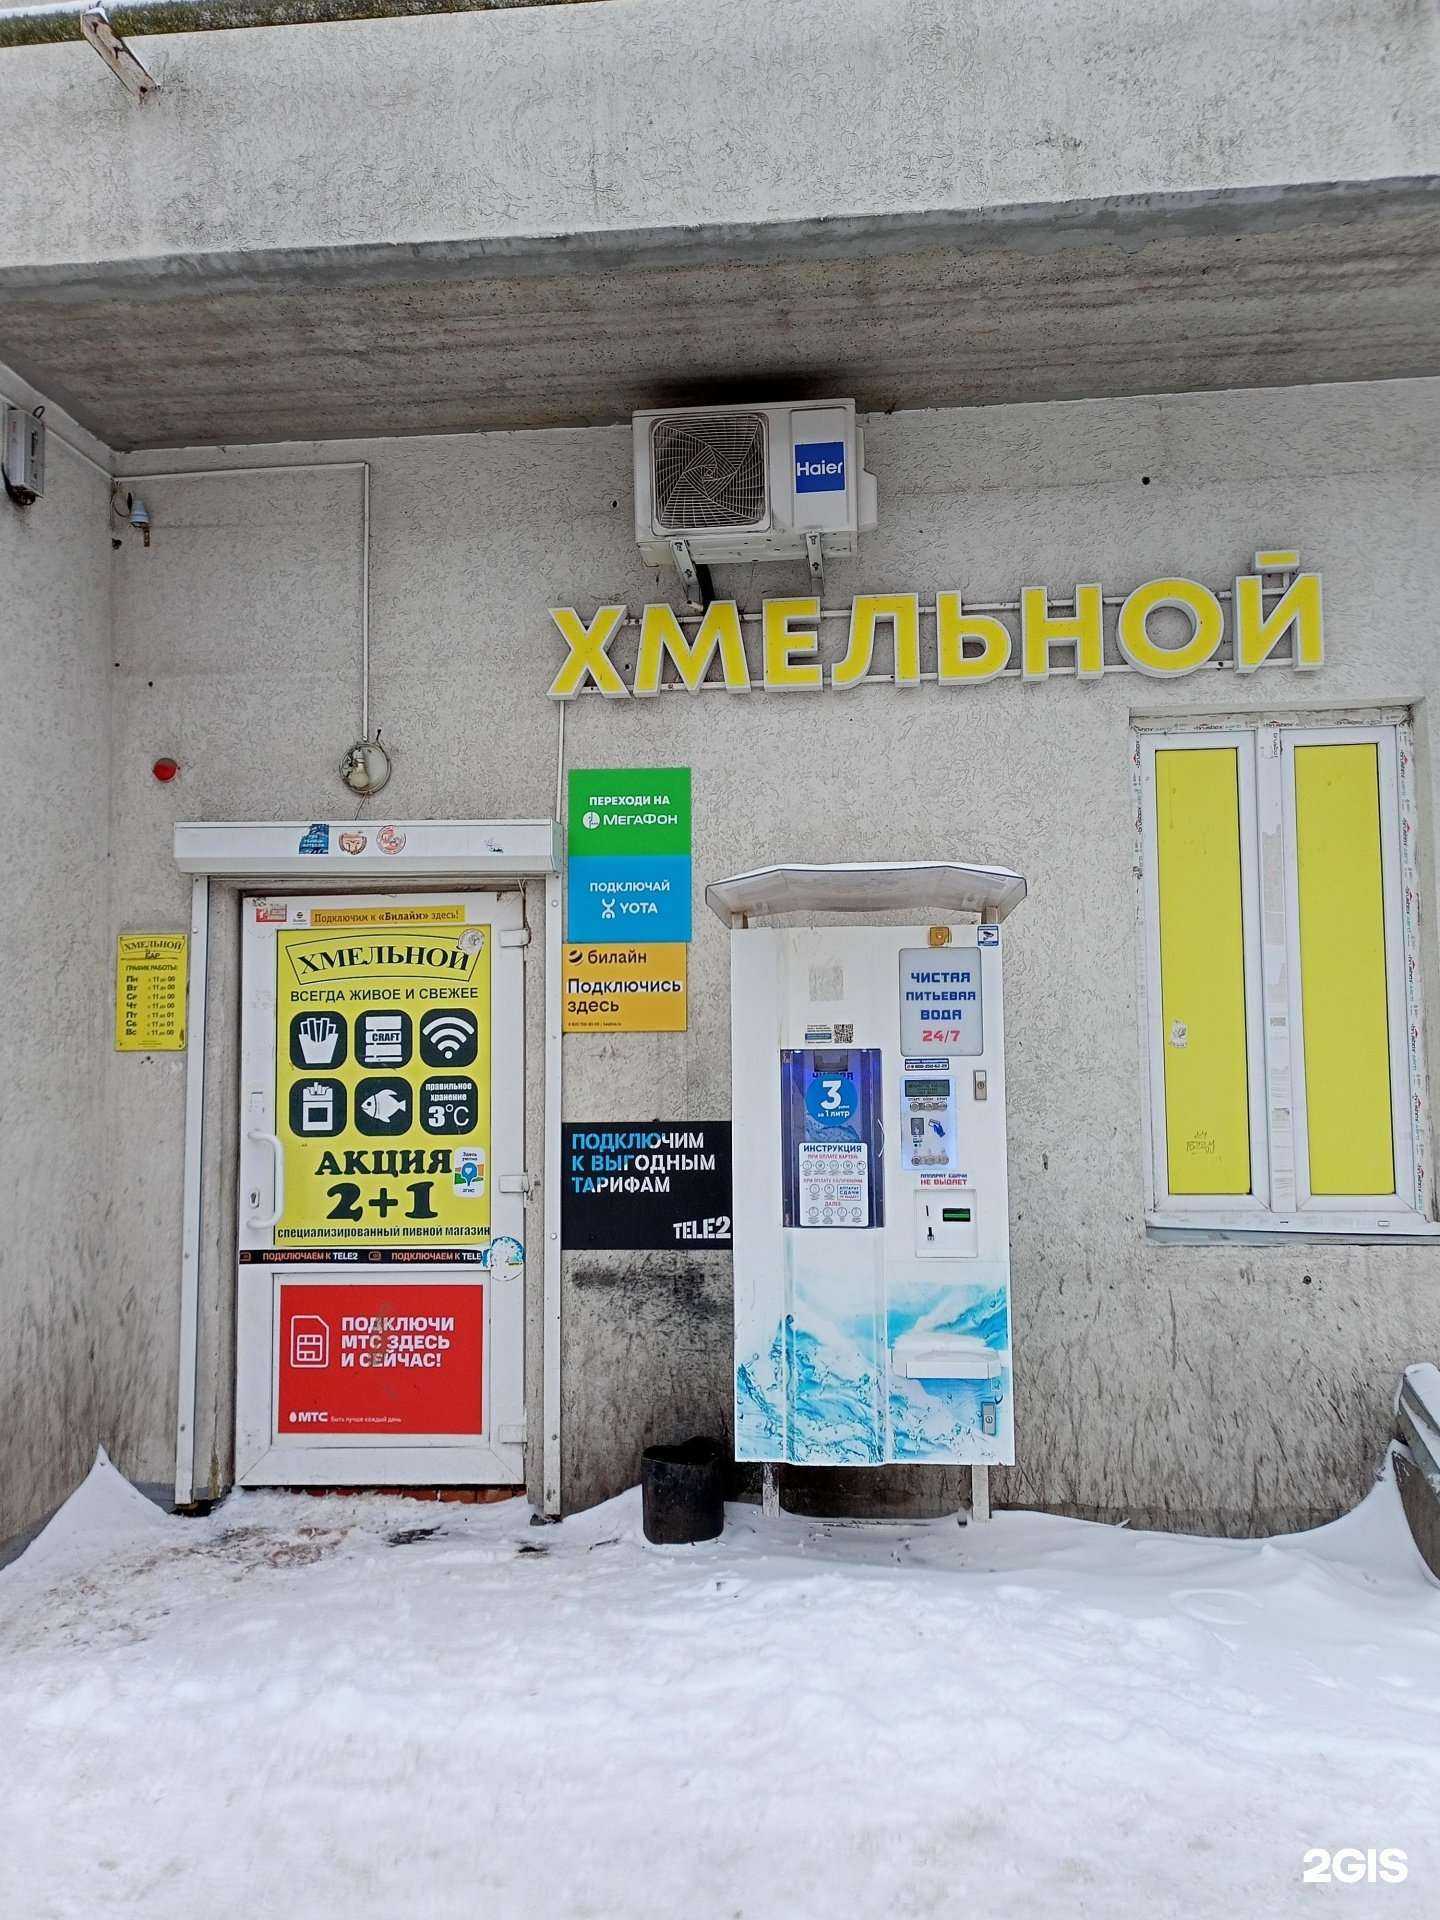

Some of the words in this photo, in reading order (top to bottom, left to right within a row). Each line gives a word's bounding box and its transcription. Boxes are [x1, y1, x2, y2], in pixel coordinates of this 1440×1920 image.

[796, 460, 844, 476] Haier
[547, 549, 1325, 699] ХМЕЛЬНОЙ
[589, 795, 651, 807] ПЕРЕХОДИ
[653, 795, 670, 805] НА
[589, 880, 670, 894] ПОДКЛЮЧАЙ
[620, 903, 658, 914] YOTA
[314, 912, 369, 924] Подключим
[588, 950, 647, 964] билайн
[911, 972, 971, 983] ЧИСТАЯ
[568, 979, 681, 995] Подключись
[290, 989, 345, 1004] ВСЕГДА
[350, 988, 401, 1001] ЖИВОЕ
[405, 988, 415, 1000] И
[419, 987, 479, 1001] СВЕЖЕЕ
[906, 991, 976, 1001] ПИТЬЕВАЯ
[568, 1001, 620, 1014] здесь
[920, 1010, 962, 1021] ВОДА
[371, 1032, 400, 1042] CRAFT
[922, 1030, 961, 1043] 24/7
[820, 1080, 842, 1110] 3
[830, 1110, 850, 1119] литр
[572, 1132, 704, 1153] ПОДКЛЮЧИМ
[803, 1145, 862, 1153] ИНСТРУКЦИЯ
[314, 1149, 453, 1178] АКЦИЯ
[572, 1155, 584, 1171] К
[591, 1154, 716, 1174] ВЫГОДНЫМ
[572, 1176, 671, 1193] ТАРИФАМ
[326, 1181, 438, 1222] 2+1
[277, 1226, 400, 1238] специализированный
[402, 1225, 443, 1237] пивной
[444, 1225, 490, 1237] магазин
[672, 1216, 731, 1239] TELE2
[263, 1252, 324, 1261] ПОДКЛЮЧАЕМ
[325, 1252, 331, 1260] К
[332, 1252, 359, 1260] TELE2
[391, 1252, 454, 1261] ПОДКЛЮЧАЕМ
[454, 1252, 460, 1260] К
[461, 1252, 482, 1260] TELE
[341, 1316, 455, 1334] ПОДКЛЮЧИ
[341, 1335, 382, 1350] МТС
[387, 1335, 450, 1351] ЗДЕСЬ
[341, 1353, 355, 1368] И
[359, 1350, 442, 1368] СЕЙЧАС!
[298, 1412, 328, 1423] МТС
